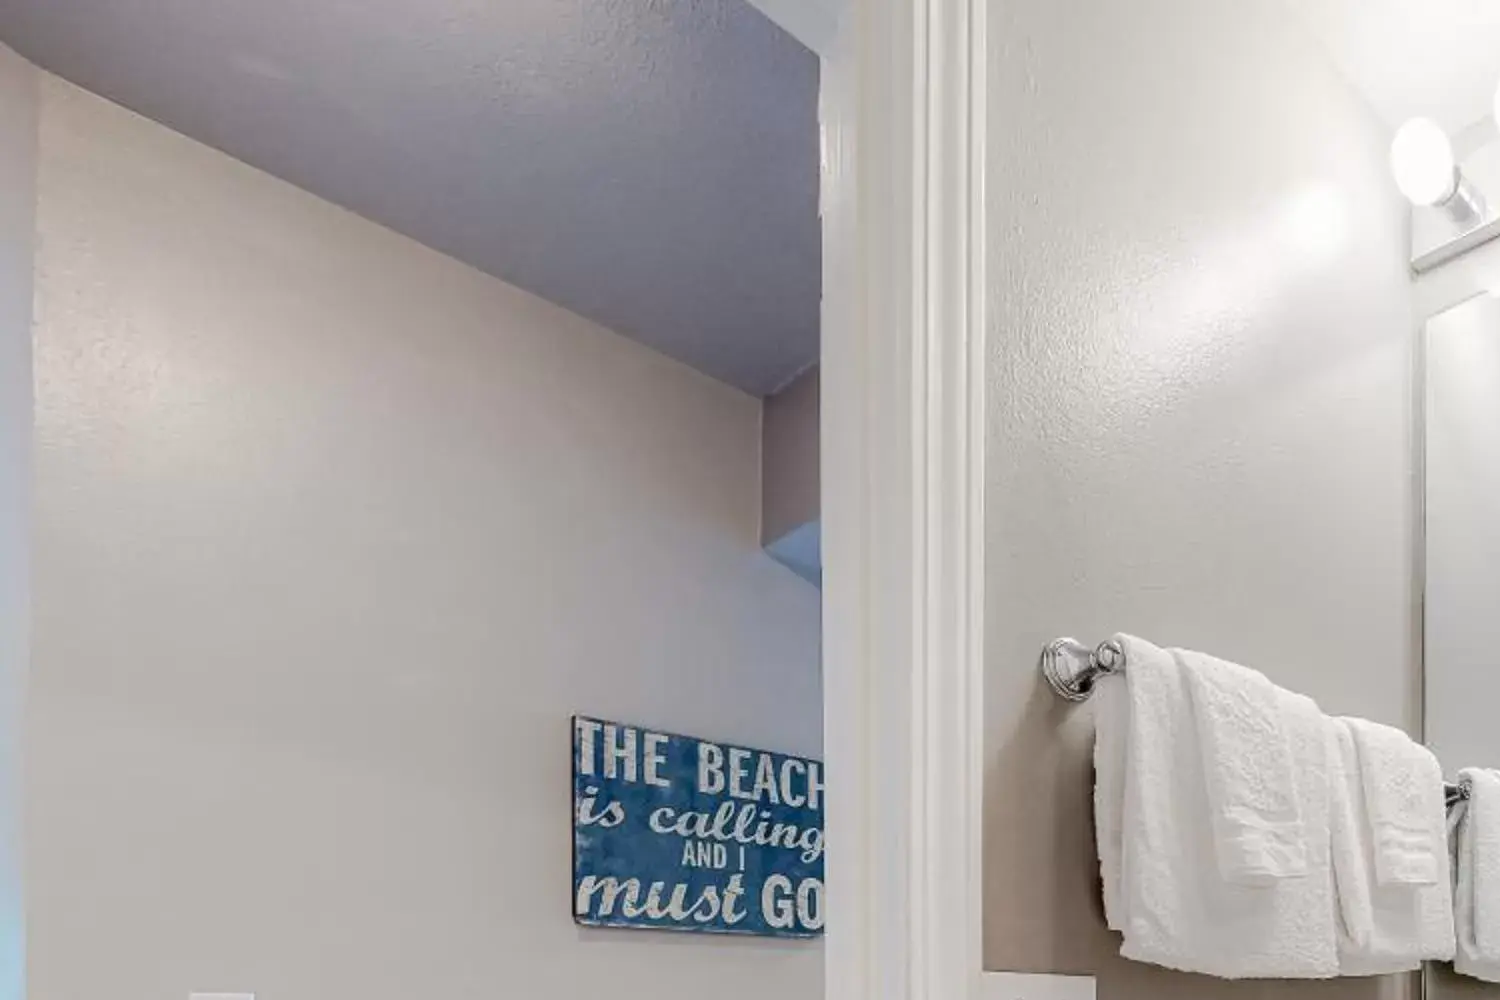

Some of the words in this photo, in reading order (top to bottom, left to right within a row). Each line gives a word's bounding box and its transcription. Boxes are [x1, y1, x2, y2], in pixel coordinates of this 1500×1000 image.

[576, 719, 671, 787] THE
[578, 785, 625, 827] is
[650, 800, 824, 864] calling
[682, 840, 727, 869] AND
[738, 845, 746, 871] I
[577, 873, 747, 924] must
[761, 873, 824, 930] GO
